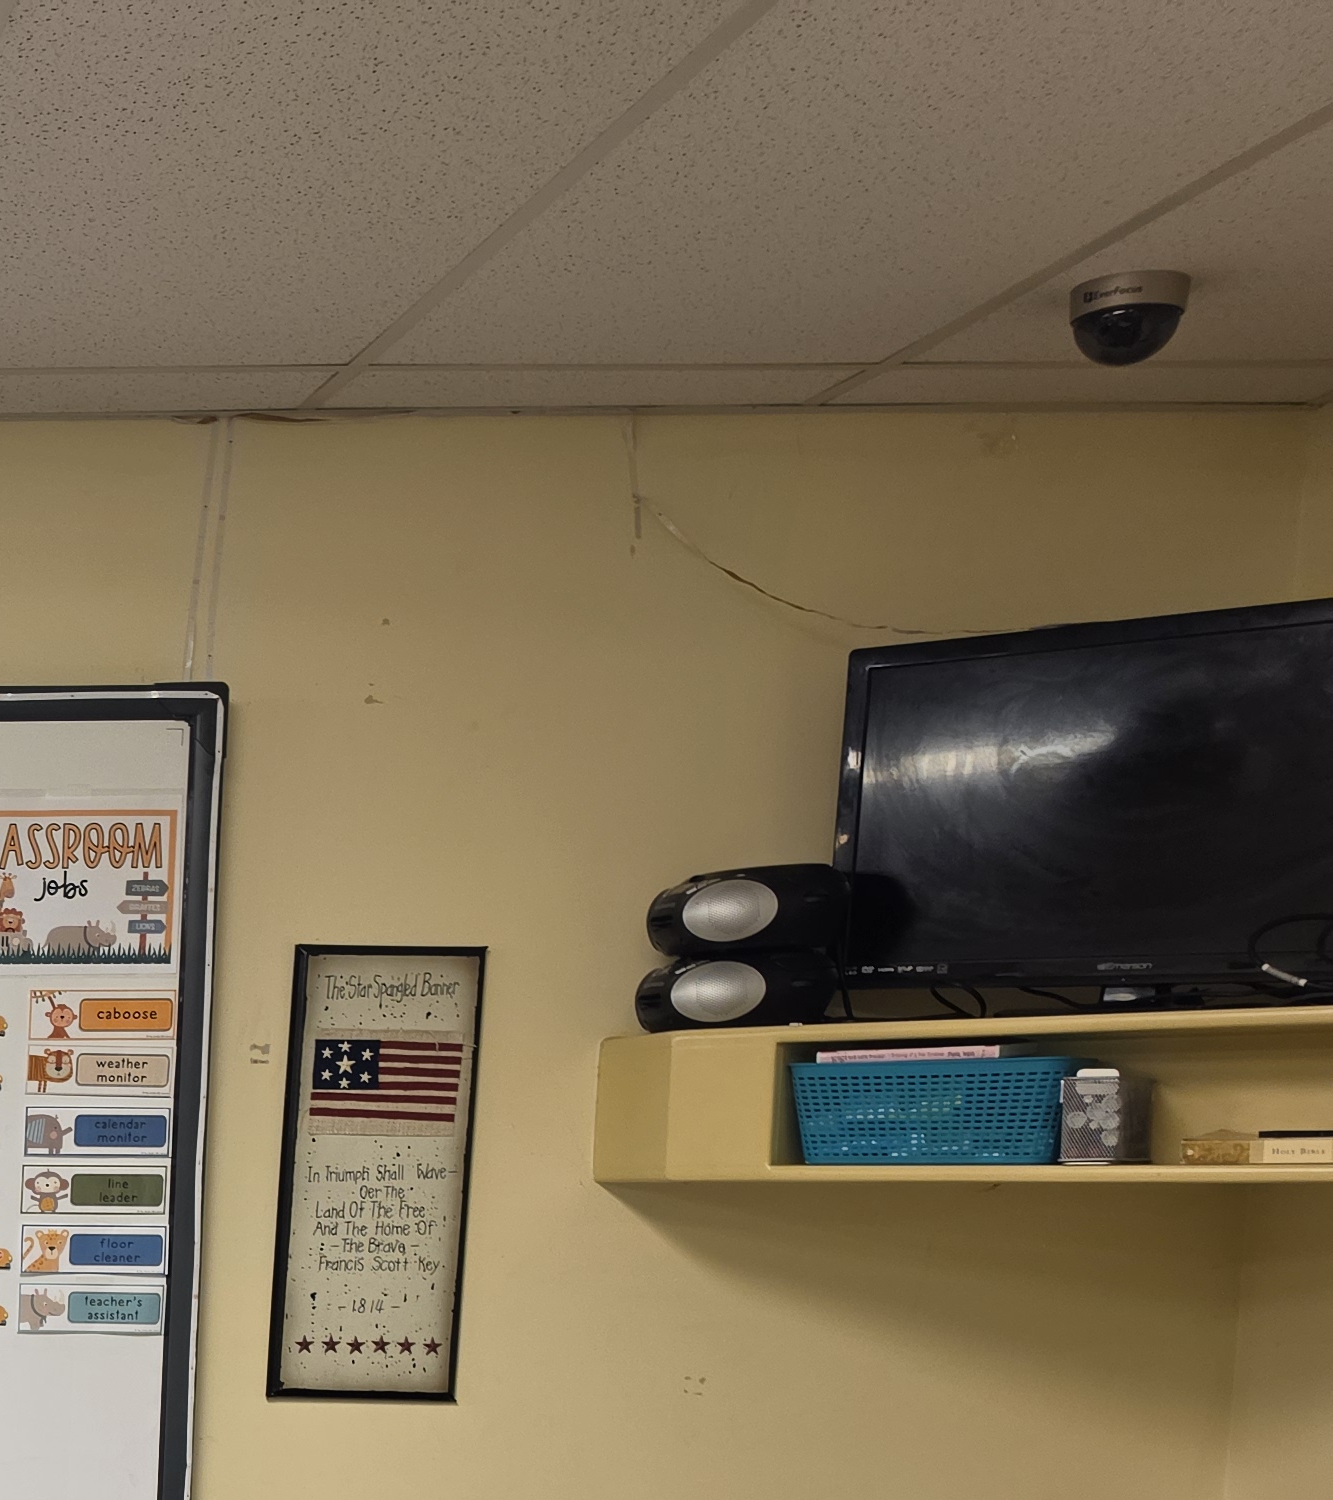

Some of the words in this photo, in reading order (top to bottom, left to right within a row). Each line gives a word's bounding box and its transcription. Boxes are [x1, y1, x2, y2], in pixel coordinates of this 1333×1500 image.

[34, 870, 89, 902] jobs
[325, 974, 346, 1000] The
[346, 974, 372, 1000] Star
[373, 973, 418, 1004] Spangled
[420, 972, 460, 998] Banner
[97, 1008, 158, 1020] caboose
[96, 1058, 148, 1070] weather
[96, 1072, 148, 1083] monitor
[107, 1178, 129, 1190] line
[99, 1192, 139, 1204] leader
[100, 1237, 135, 1249] floor
[94, 1252, 141, 1264] cleaner
[318, 1256, 364, 1272] Francis
[372, 1256, 409, 1272] Scott
[85, 1295, 143, 1308] teacher's
[87, 1309, 139, 1321] assistant
